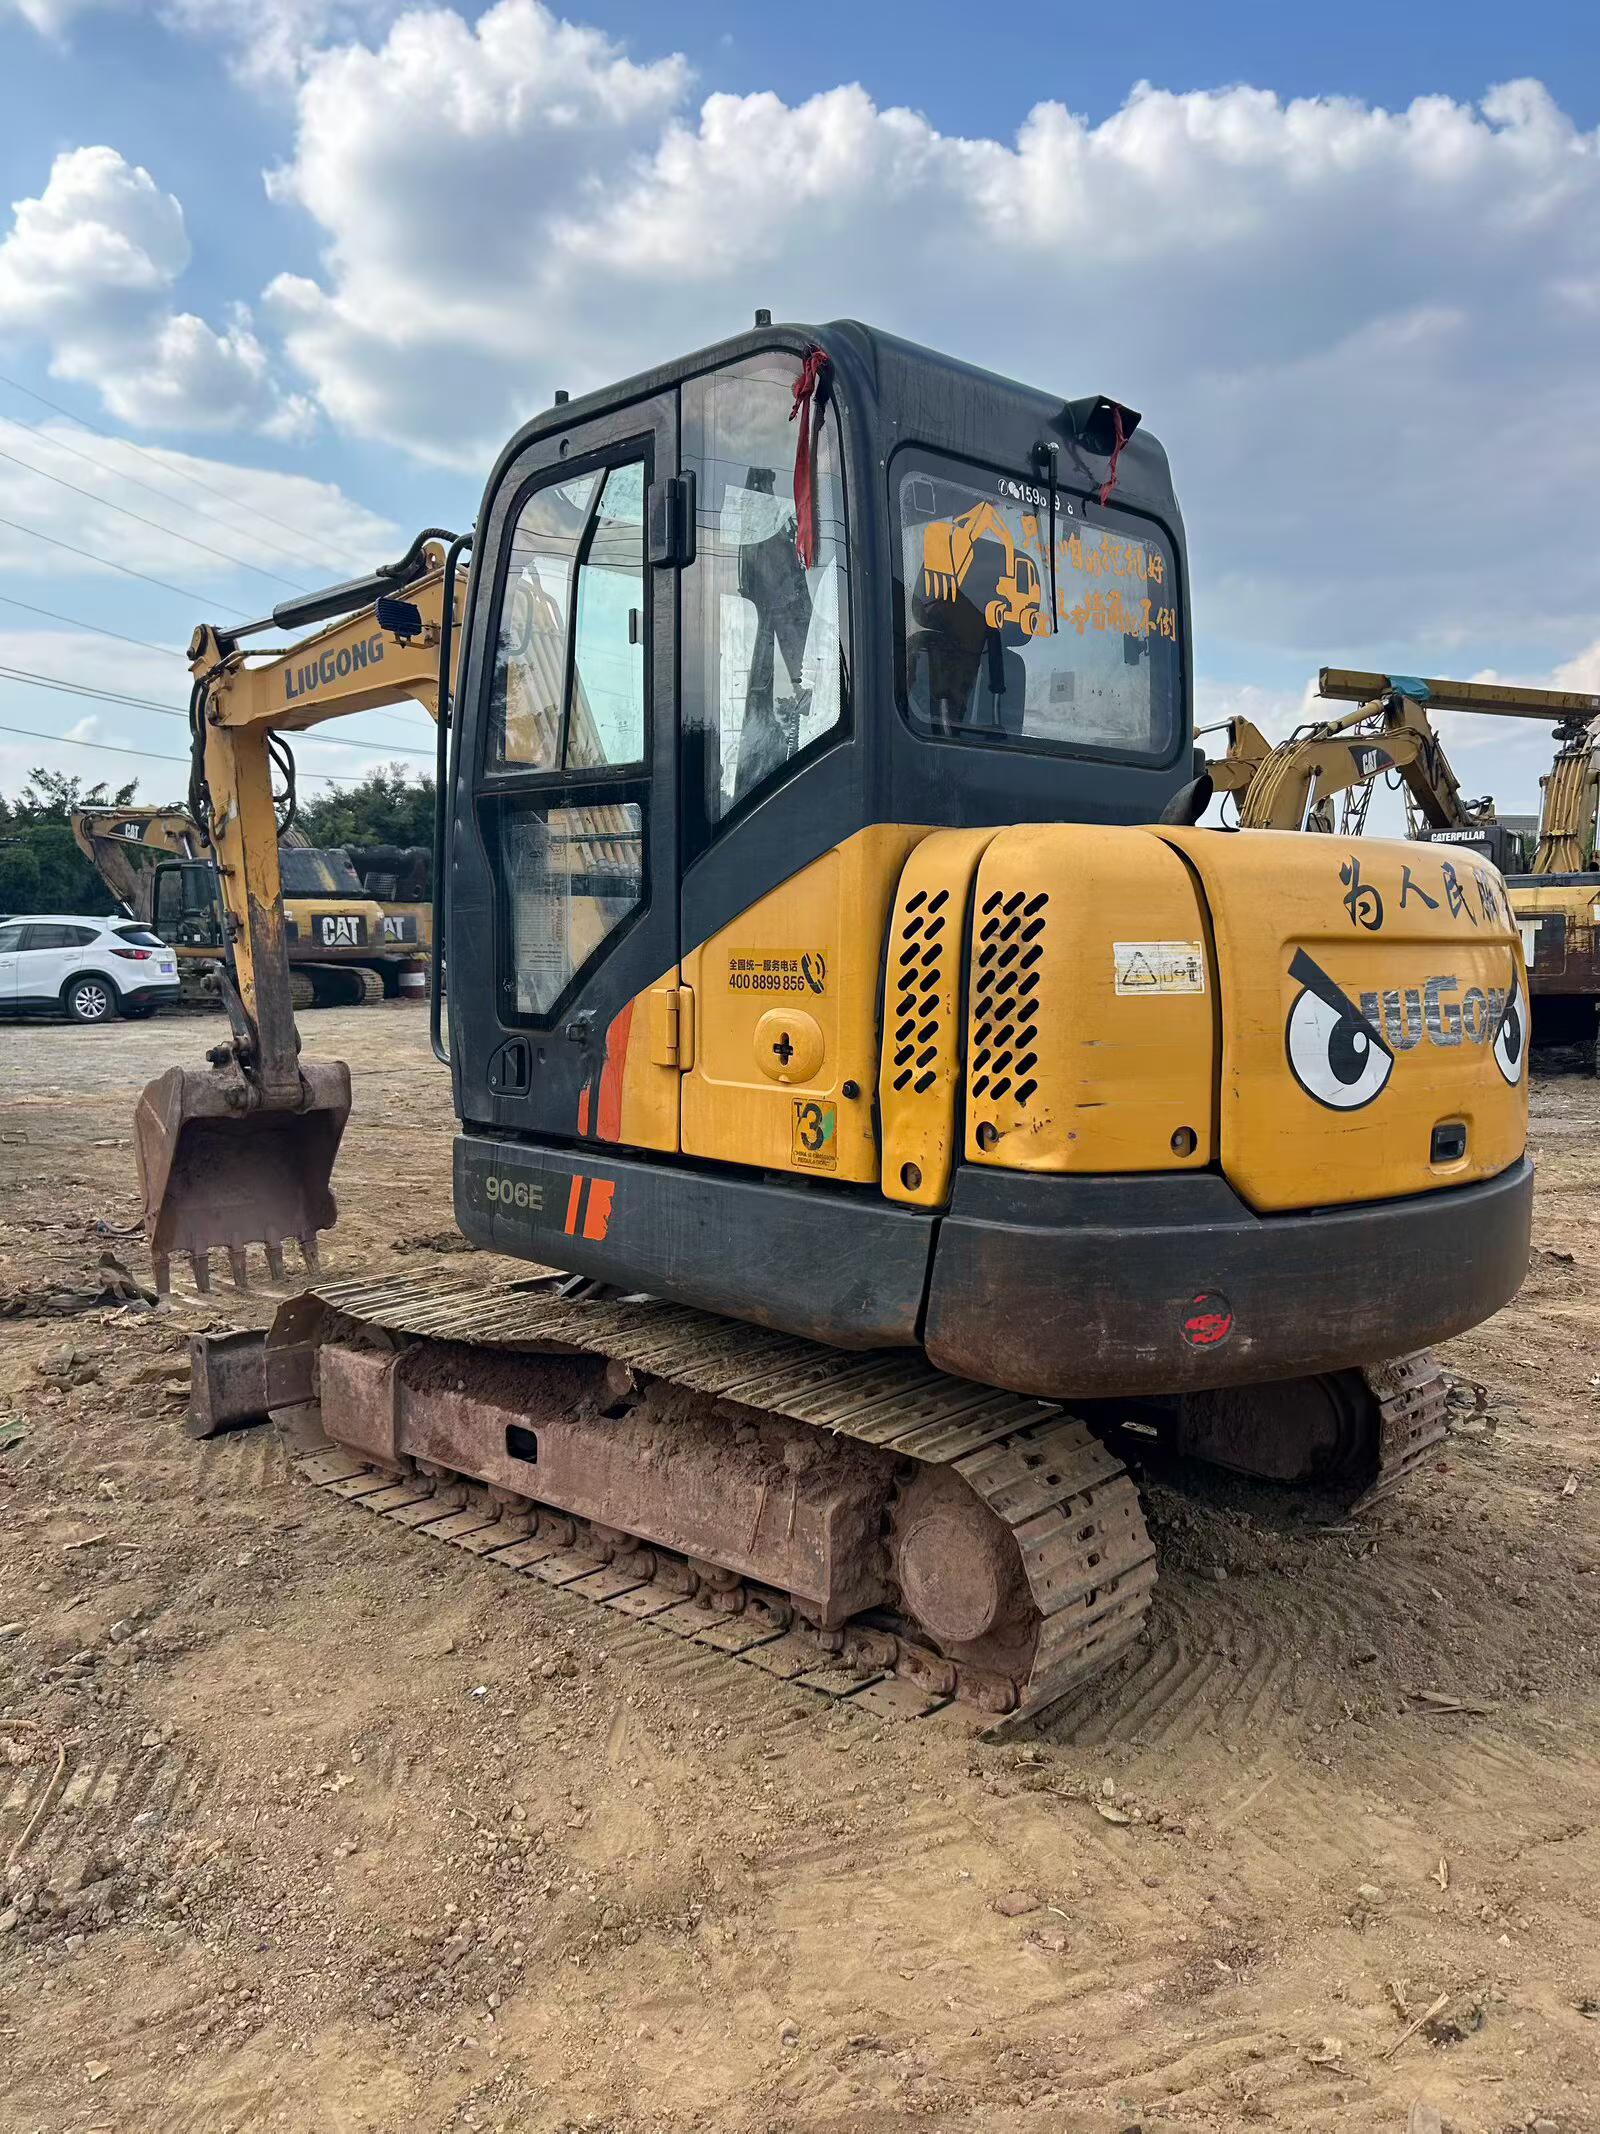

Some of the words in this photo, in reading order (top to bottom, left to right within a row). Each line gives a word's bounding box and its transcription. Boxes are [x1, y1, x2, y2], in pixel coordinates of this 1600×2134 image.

[1362, 749, 1378, 775] CAT
[125, 823, 140, 839] CAT
[1431, 830, 1486, 842] CATERPILLAR
[322, 916, 360, 946] CAT
[383, 917, 405, 941] AT
[729, 958, 798, 972] 全国统一服务电话
[485, 1176, 544, 1211] 906E
